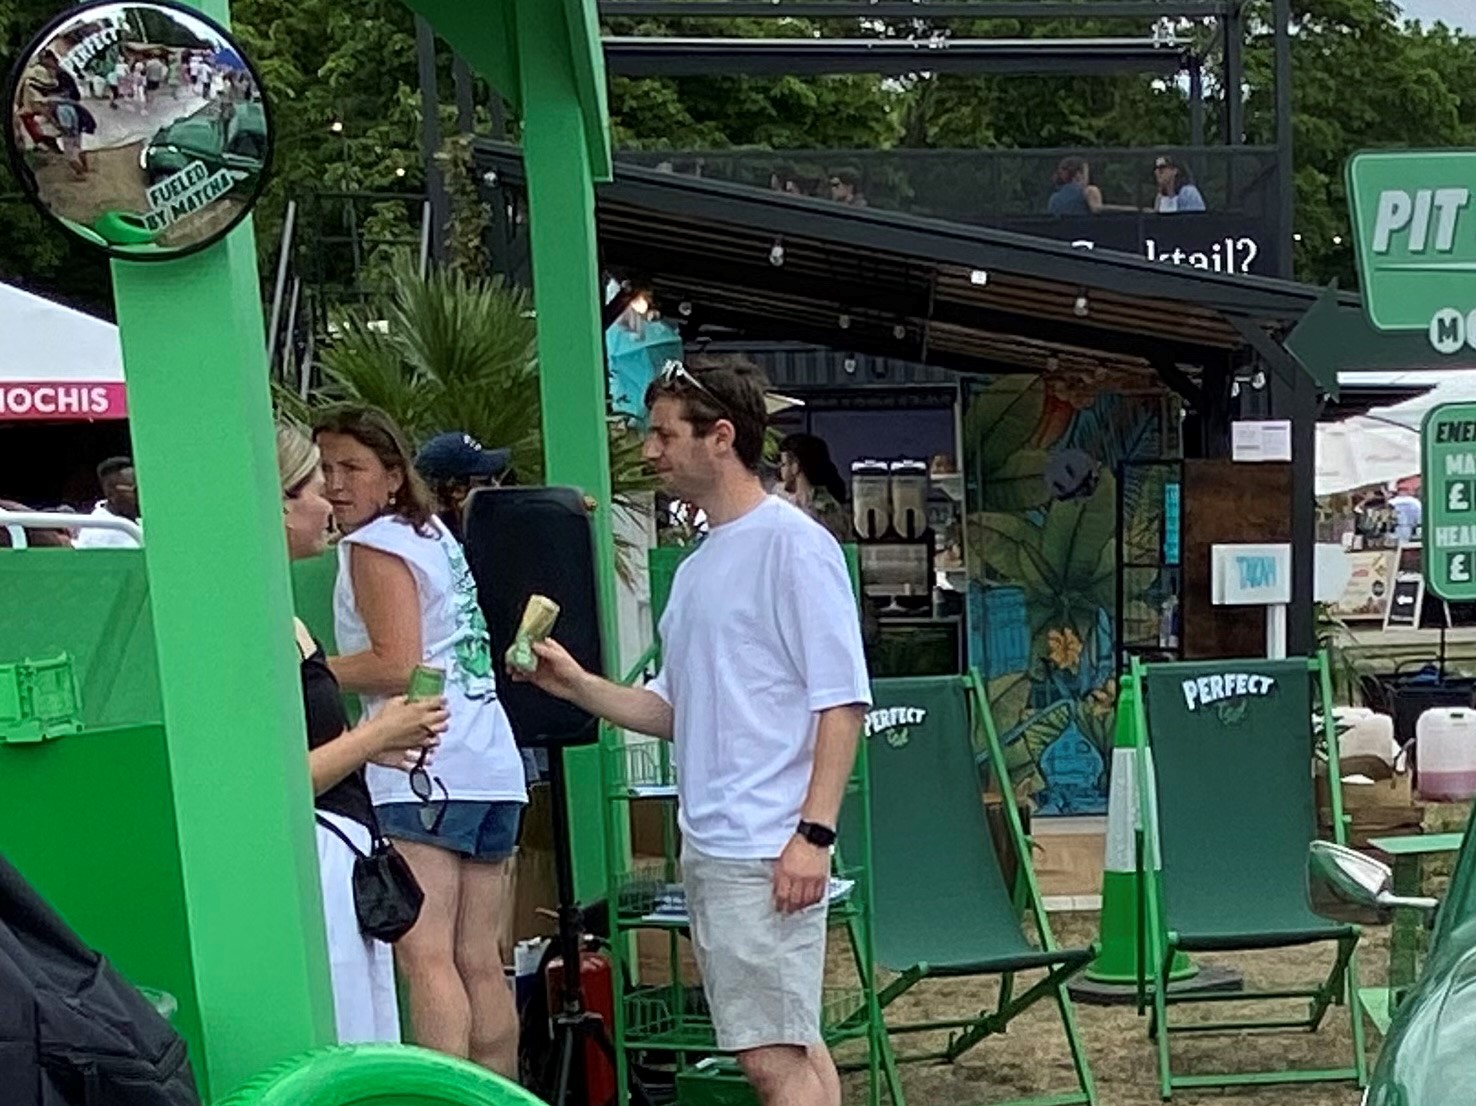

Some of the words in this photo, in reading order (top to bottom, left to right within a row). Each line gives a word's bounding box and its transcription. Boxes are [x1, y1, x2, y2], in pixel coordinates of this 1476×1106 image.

[146, 208, 167, 230] BY
[172, 172, 232, 221] MATCHA
[150, 164, 206, 206] FUELED
[1372, 188, 1469, 253] PIT
[0, 387, 109, 413] OCHIS
[1182, 673, 1275, 711] PERFECT
[864, 707, 927, 737] PERFECT
